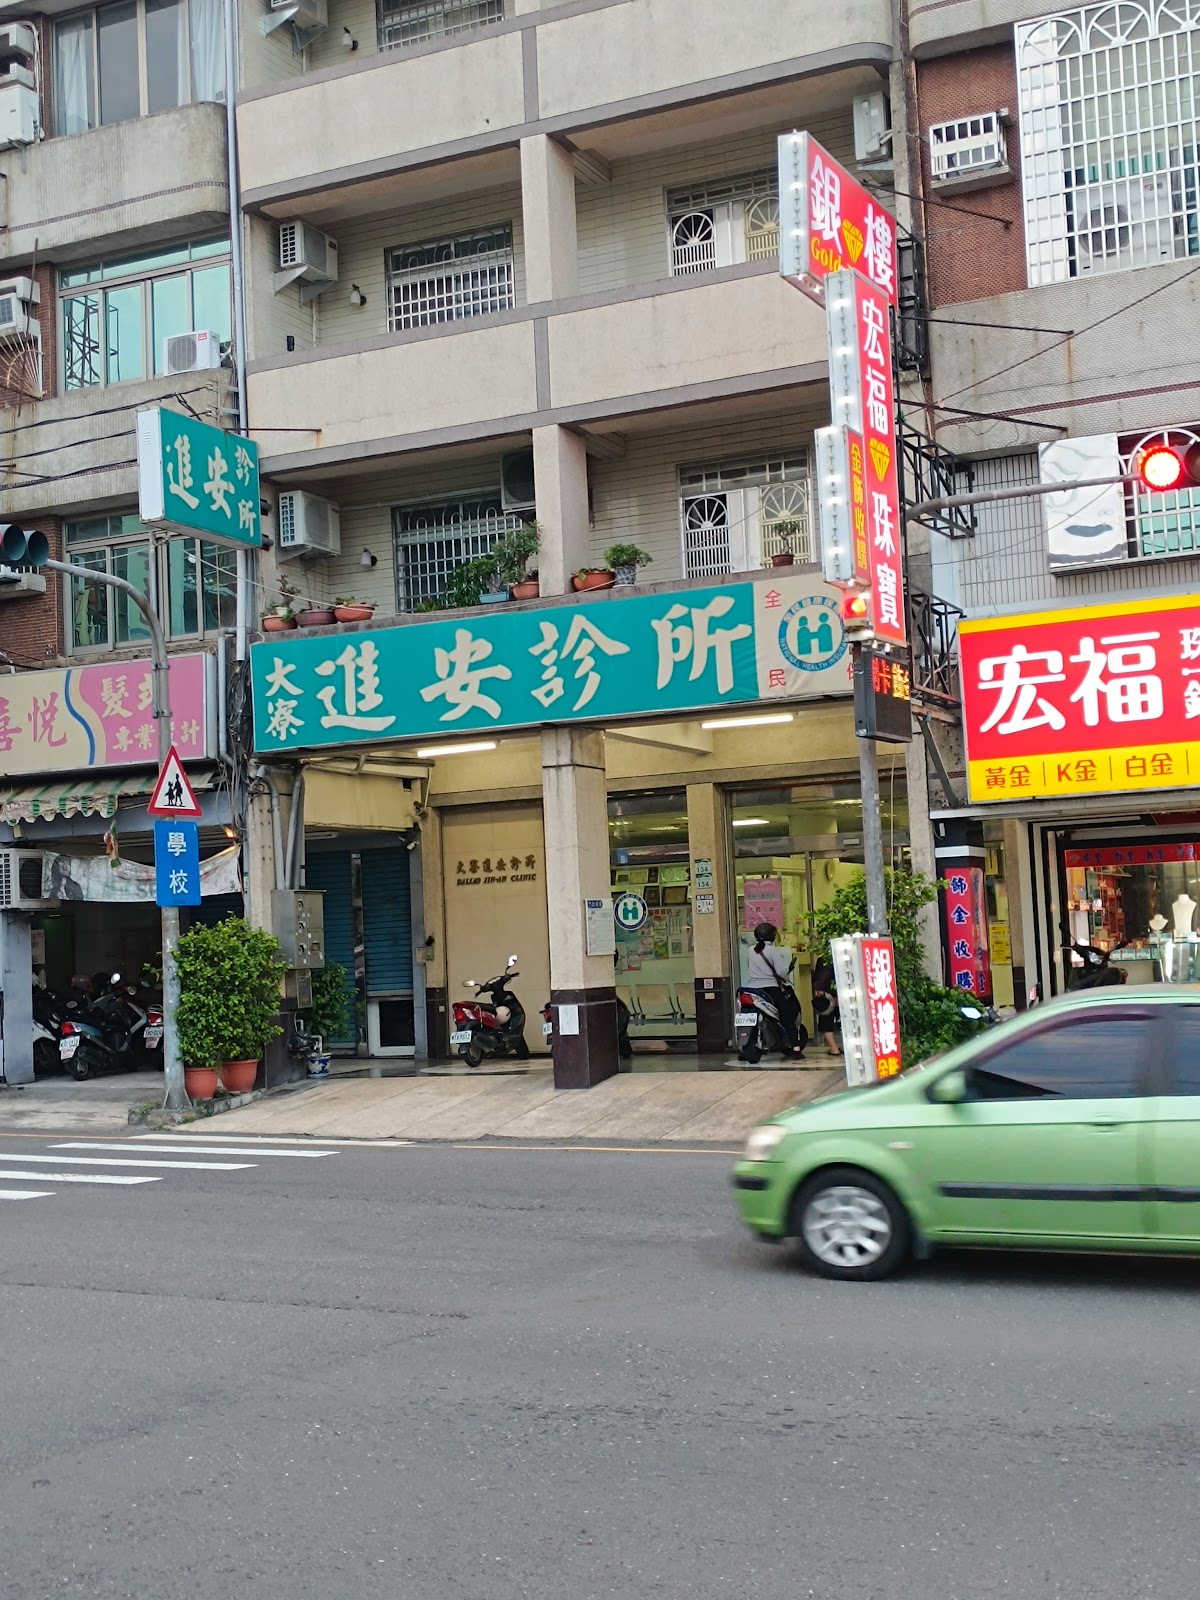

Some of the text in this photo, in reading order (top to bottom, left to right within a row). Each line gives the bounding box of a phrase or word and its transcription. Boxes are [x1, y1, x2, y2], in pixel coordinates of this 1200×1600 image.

[810, 236, 842, 273] Gold
[811, 154, 894, 295] 銀樓
[861, 297, 889, 436] 宏福
[165, 433, 235, 520] 進安
[234, 444, 257, 538] 診所
[851, 442, 868, 571] 金飾收購
[871, 490, 900, 630] 珠寶
[264, 656, 306, 742] 大寮
[313, 595, 753, 732] 進安診所
[780, 637, 800, 667] NATIONAL
[802, 662, 829, 672] HEALTH
[977, 630, 1165, 736] 宏福
[984, 751, 1174, 790] 黃金 K金 白金
[166, 831, 189, 895] 學校
[950, 875, 975, 990] 飾金收購
[871, 947, 898, 1055] 銀樓
